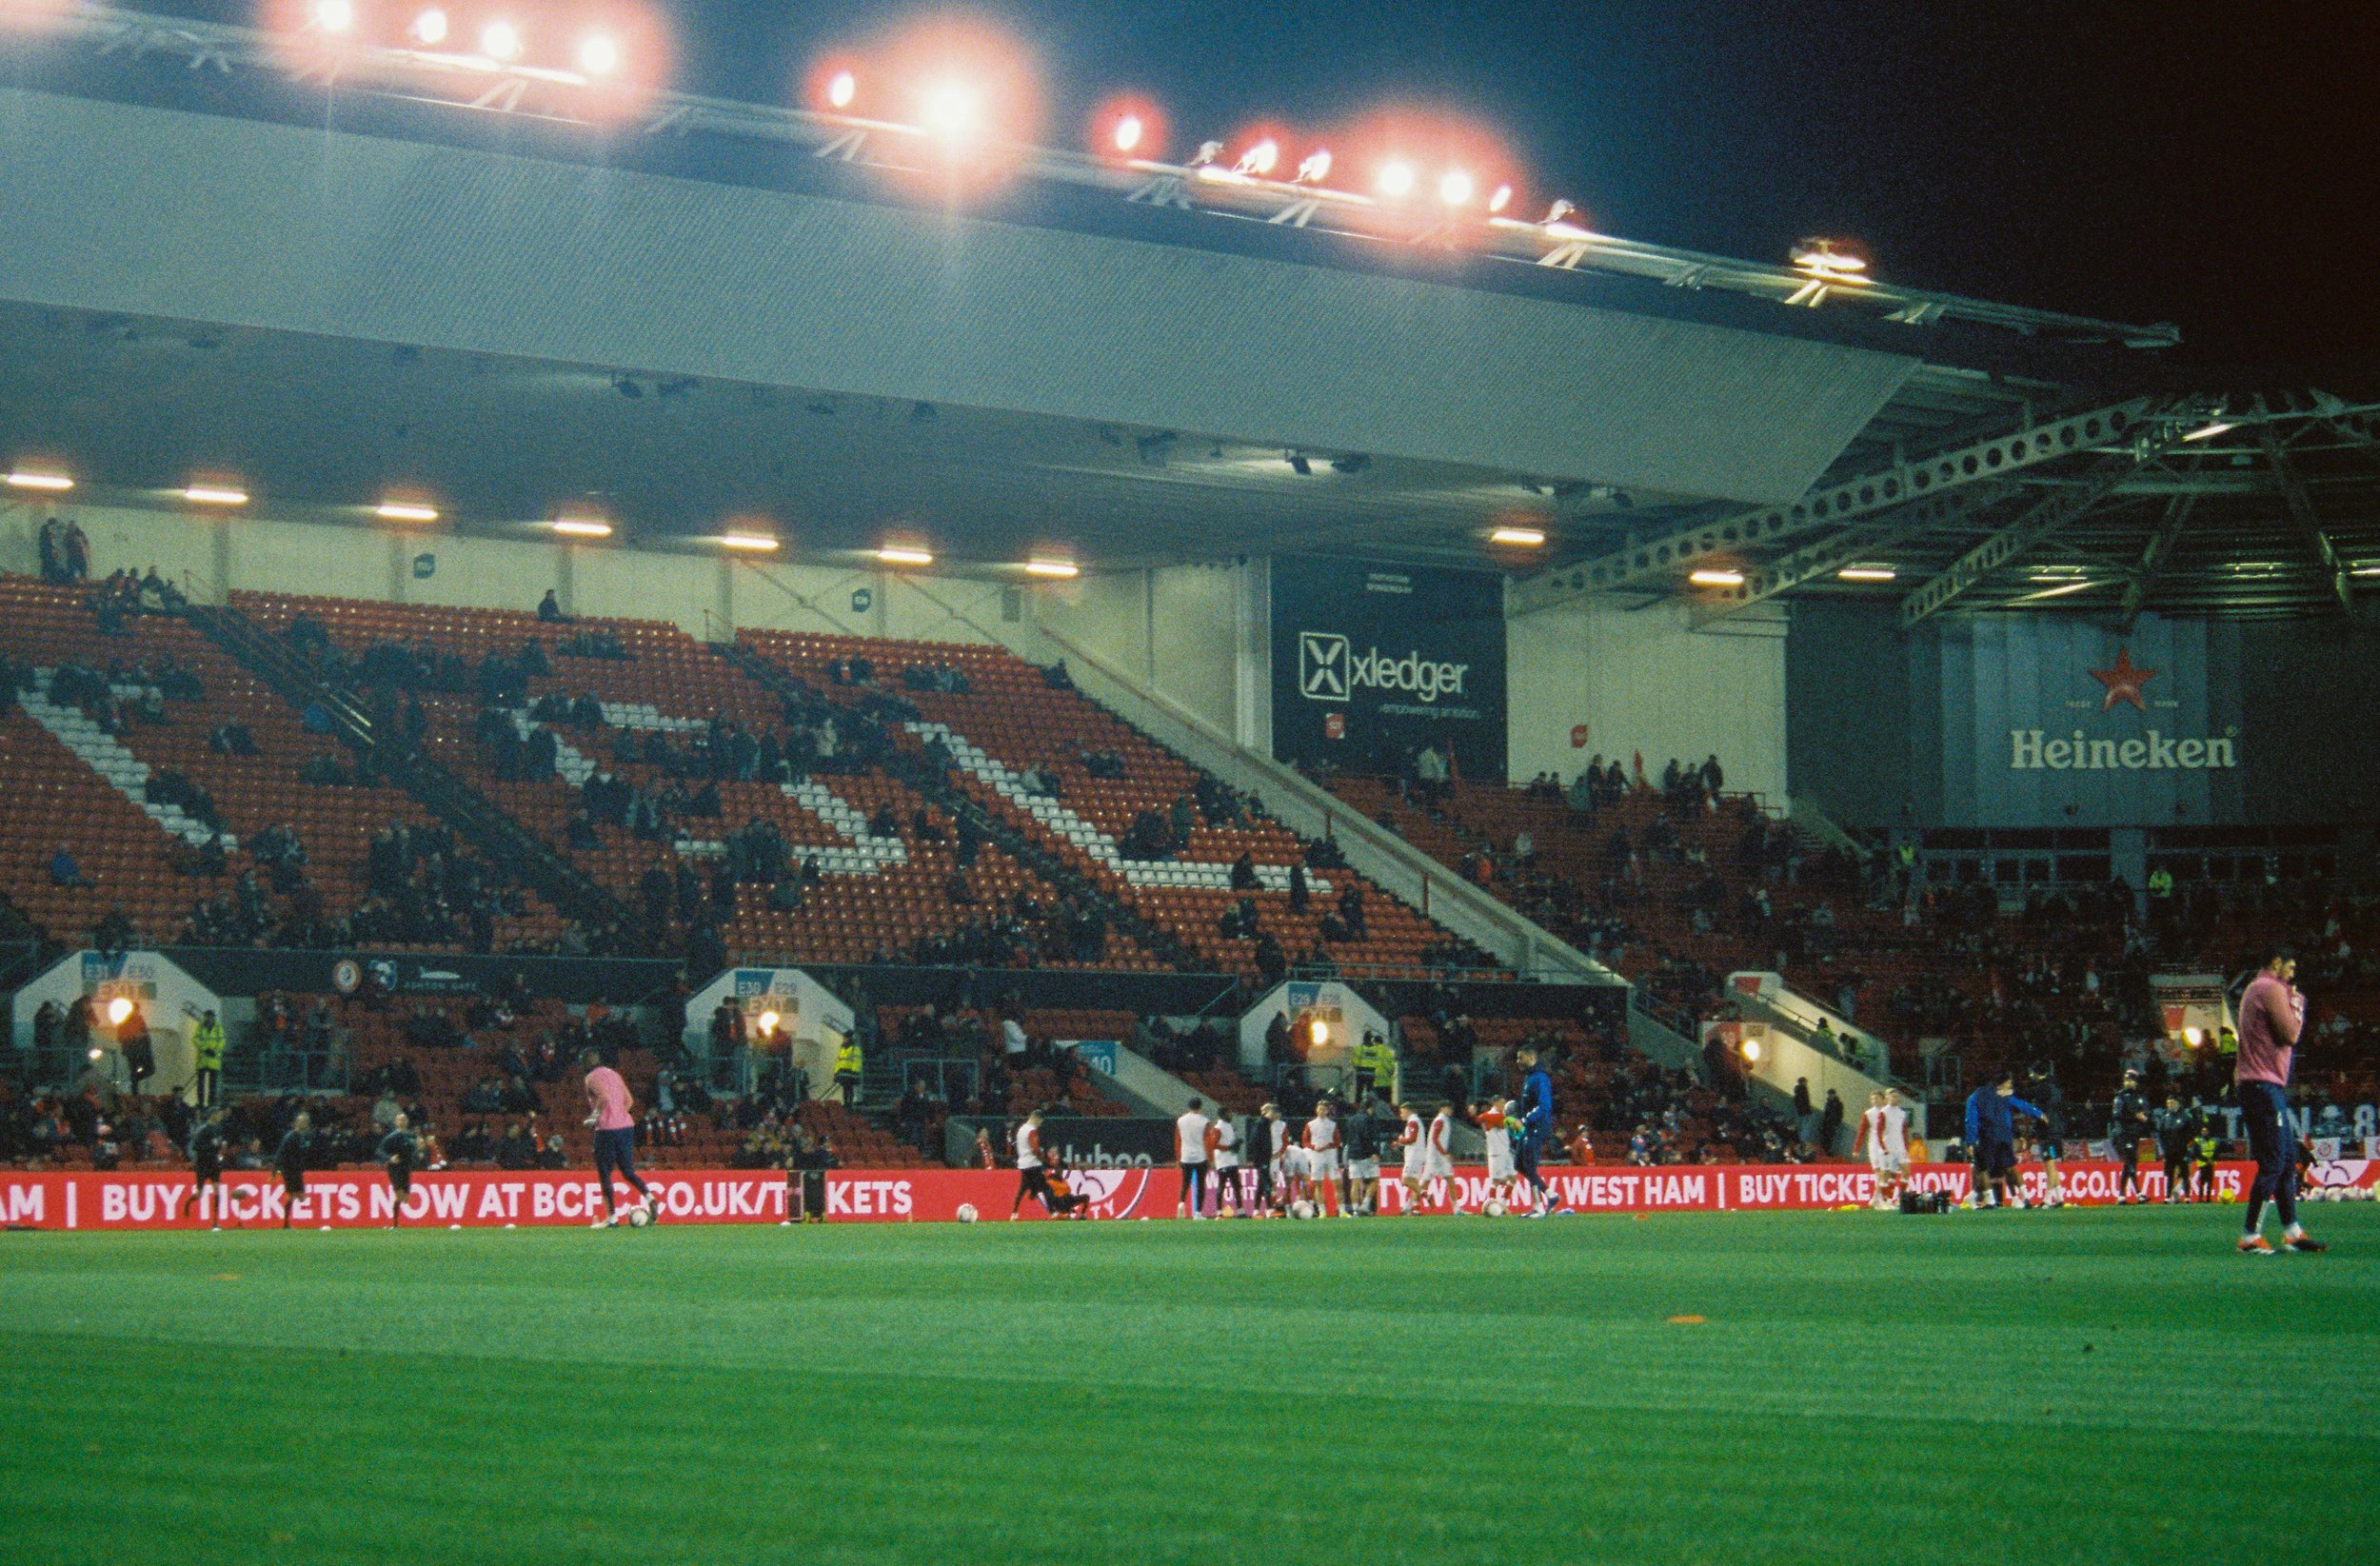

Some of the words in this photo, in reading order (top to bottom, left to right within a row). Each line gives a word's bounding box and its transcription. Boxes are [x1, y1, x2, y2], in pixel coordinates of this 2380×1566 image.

[1352, 646, 1469, 702] xledger
[2010, 729, 2236, 769] Heineken
[102, 1183, 186, 1221] BUY
[369, 1183, 470, 1219] NOW
[477, 1182, 526, 1219] AT
[1561, 1176, 1639, 1206] WEST
[1643, 1176, 1706, 1205] HAM
[1739, 1174, 1791, 1203] BUY
[1795, 1172, 1899, 1202] TICKE
[1906, 1172, 1967, 1200] NOW
